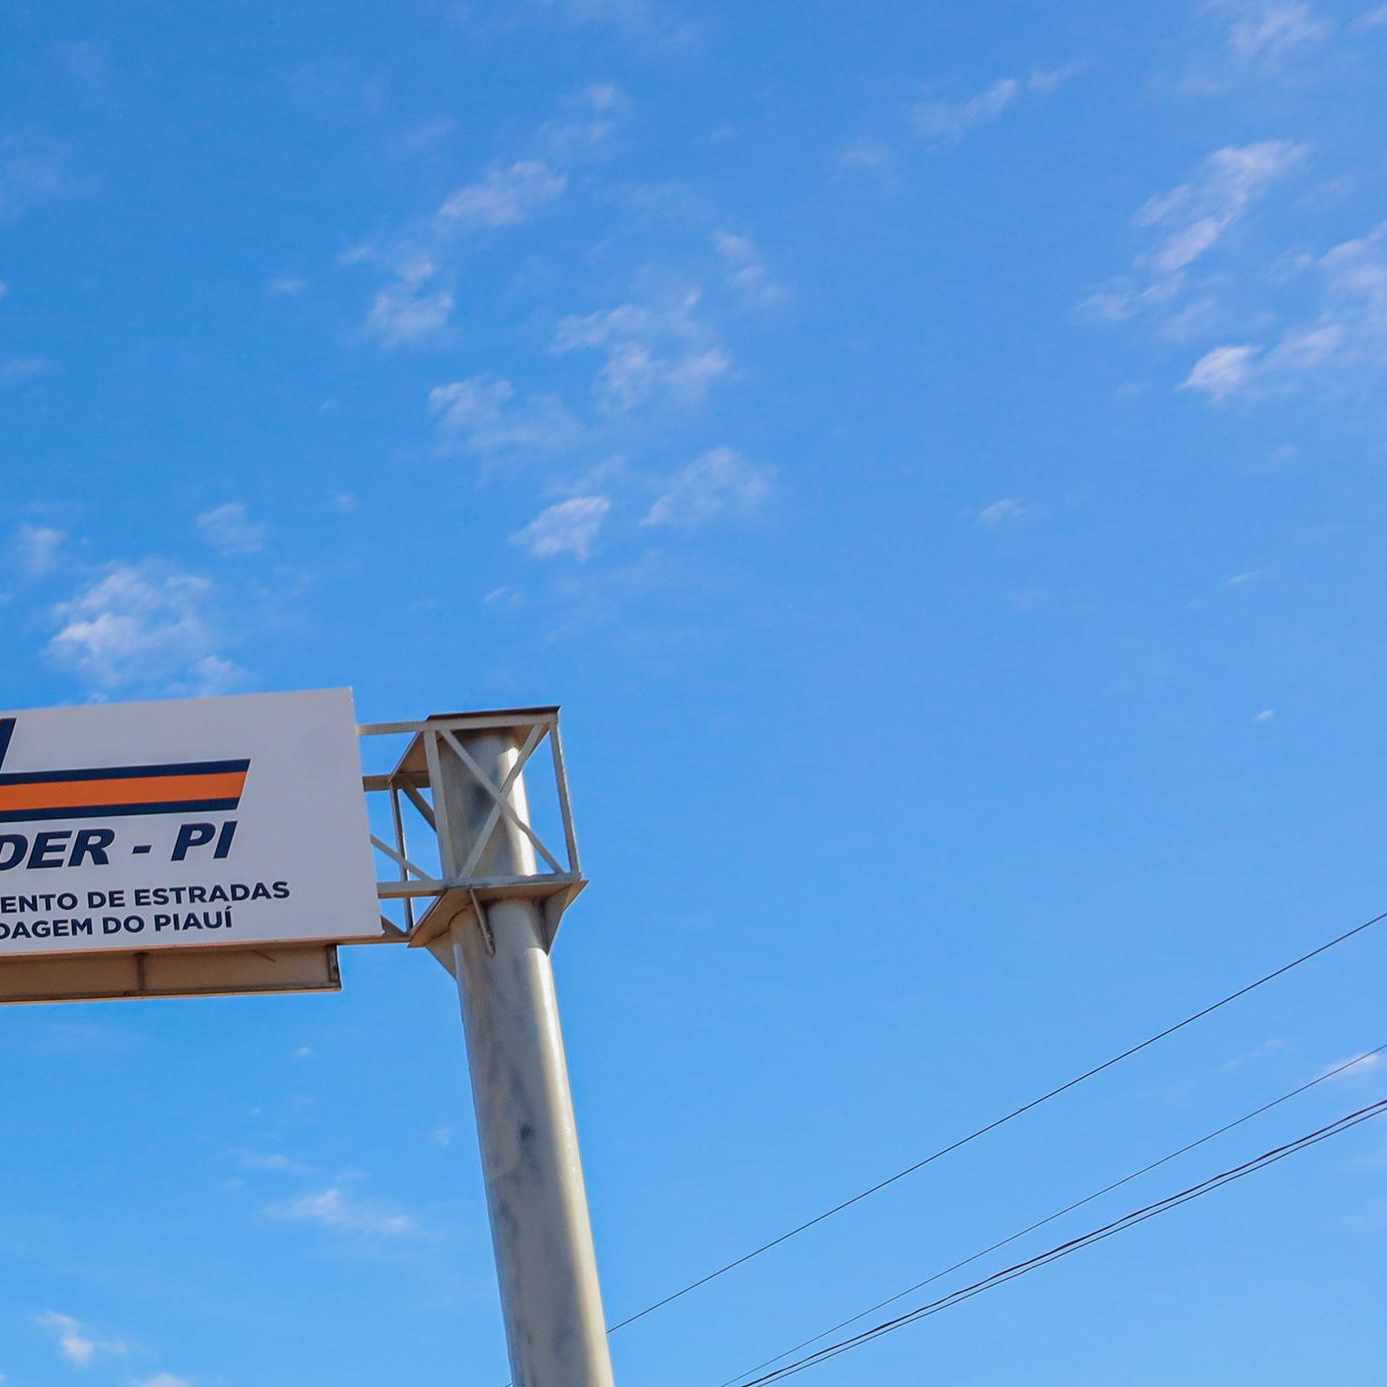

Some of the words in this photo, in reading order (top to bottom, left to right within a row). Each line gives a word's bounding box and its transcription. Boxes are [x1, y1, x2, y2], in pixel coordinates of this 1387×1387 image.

[133, 845, 151, 855] -
[171, 821, 237, 861] PI
[87, 891, 126, 909] DE
[134, 881, 291, 907] ESTRADAS
[102, 915, 145, 934] DO
[154, 905, 233, 932] PIAUÍ
